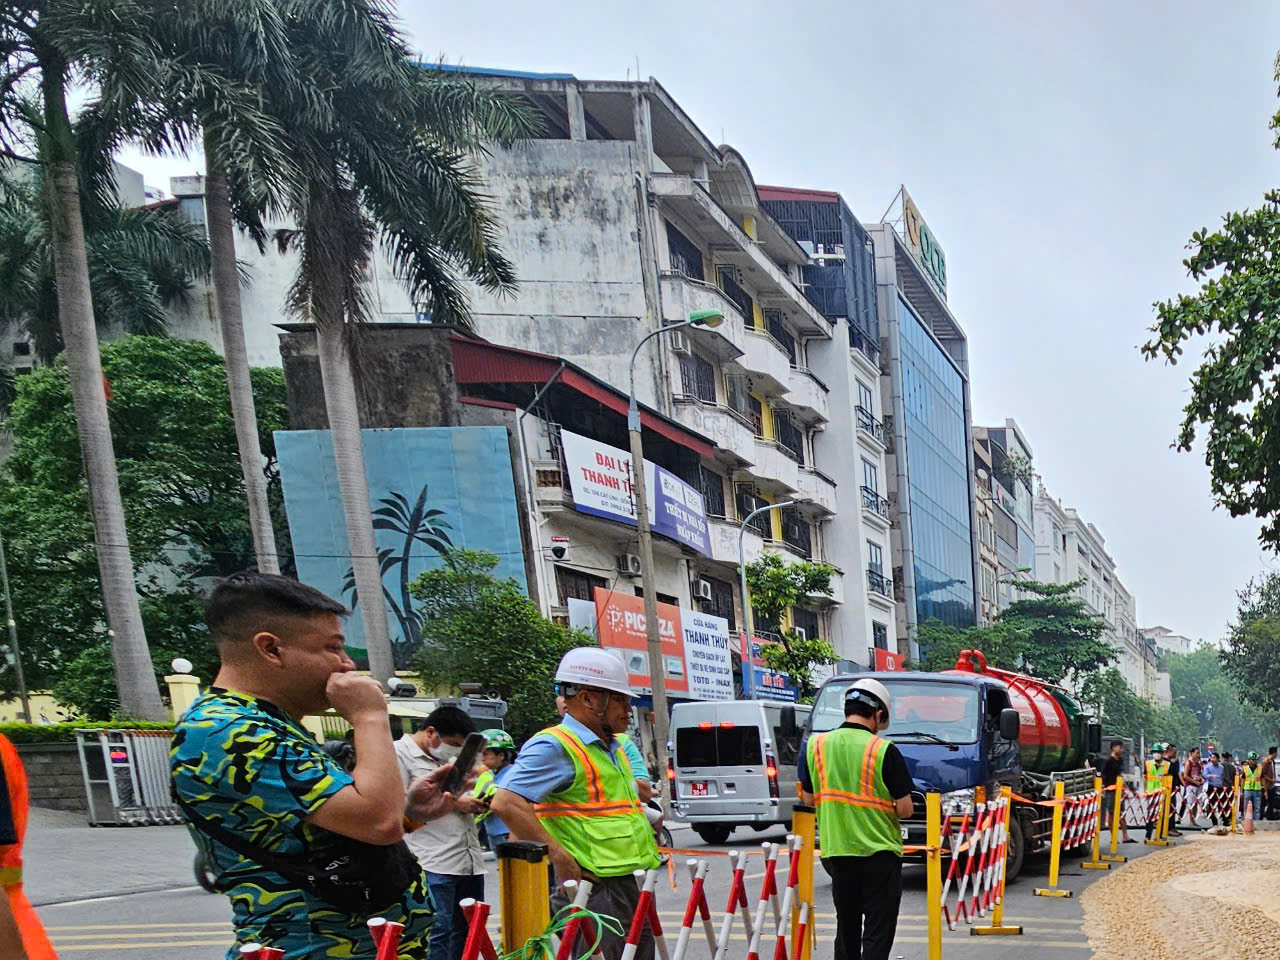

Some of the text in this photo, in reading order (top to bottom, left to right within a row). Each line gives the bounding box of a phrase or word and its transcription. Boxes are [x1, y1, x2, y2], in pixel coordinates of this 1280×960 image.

[595, 452, 615, 471] ĐẠI
[581, 467, 620, 490] THANH
[624, 610, 675, 638] PICZA
[685, 629, 711, 646] THANH
[693, 676, 731, 687] TOTO INAX
